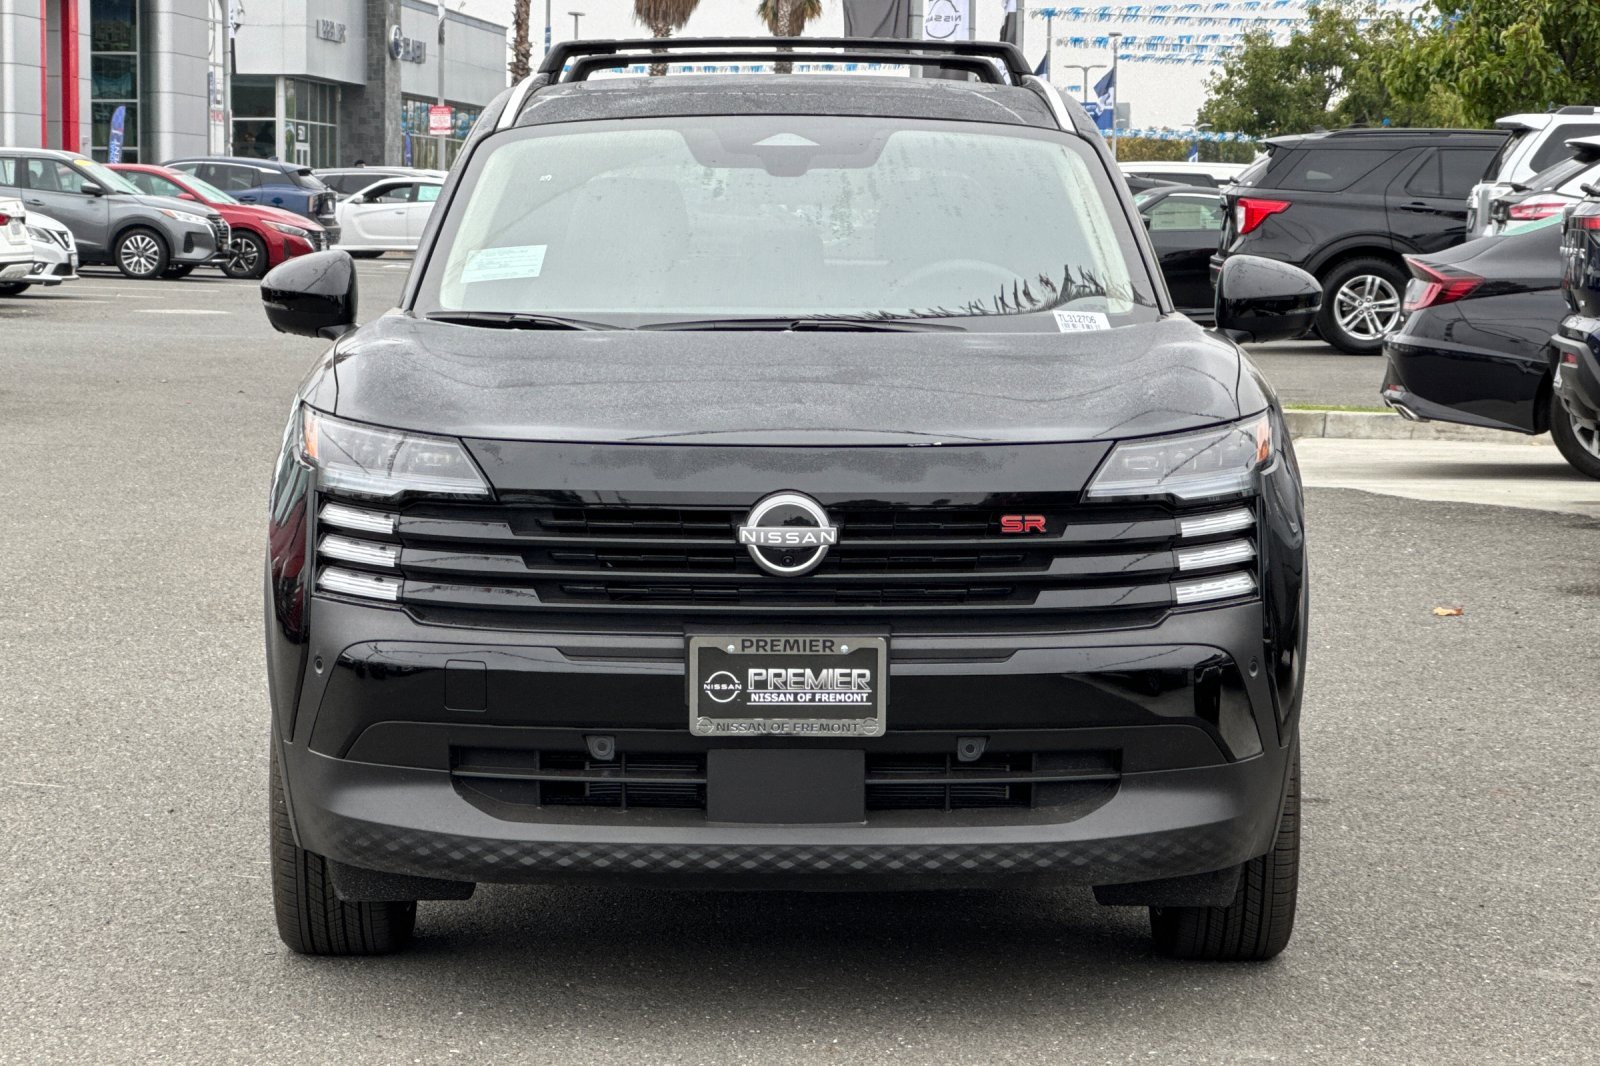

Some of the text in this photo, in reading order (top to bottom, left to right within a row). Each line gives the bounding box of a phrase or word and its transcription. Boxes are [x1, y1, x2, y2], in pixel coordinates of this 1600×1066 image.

[1000, 515, 1047, 533] SR
[741, 529, 836, 544] NISSAN
[741, 639, 835, 653] PREMIER
[747, 668, 871, 691] PREMIER
[751, 693, 869, 702] NISSAN OF FREMONT
[716, 722, 767, 733] NISSAN
[770, 722, 790, 733] OF
[793, 722, 860, 733] FREMONT
